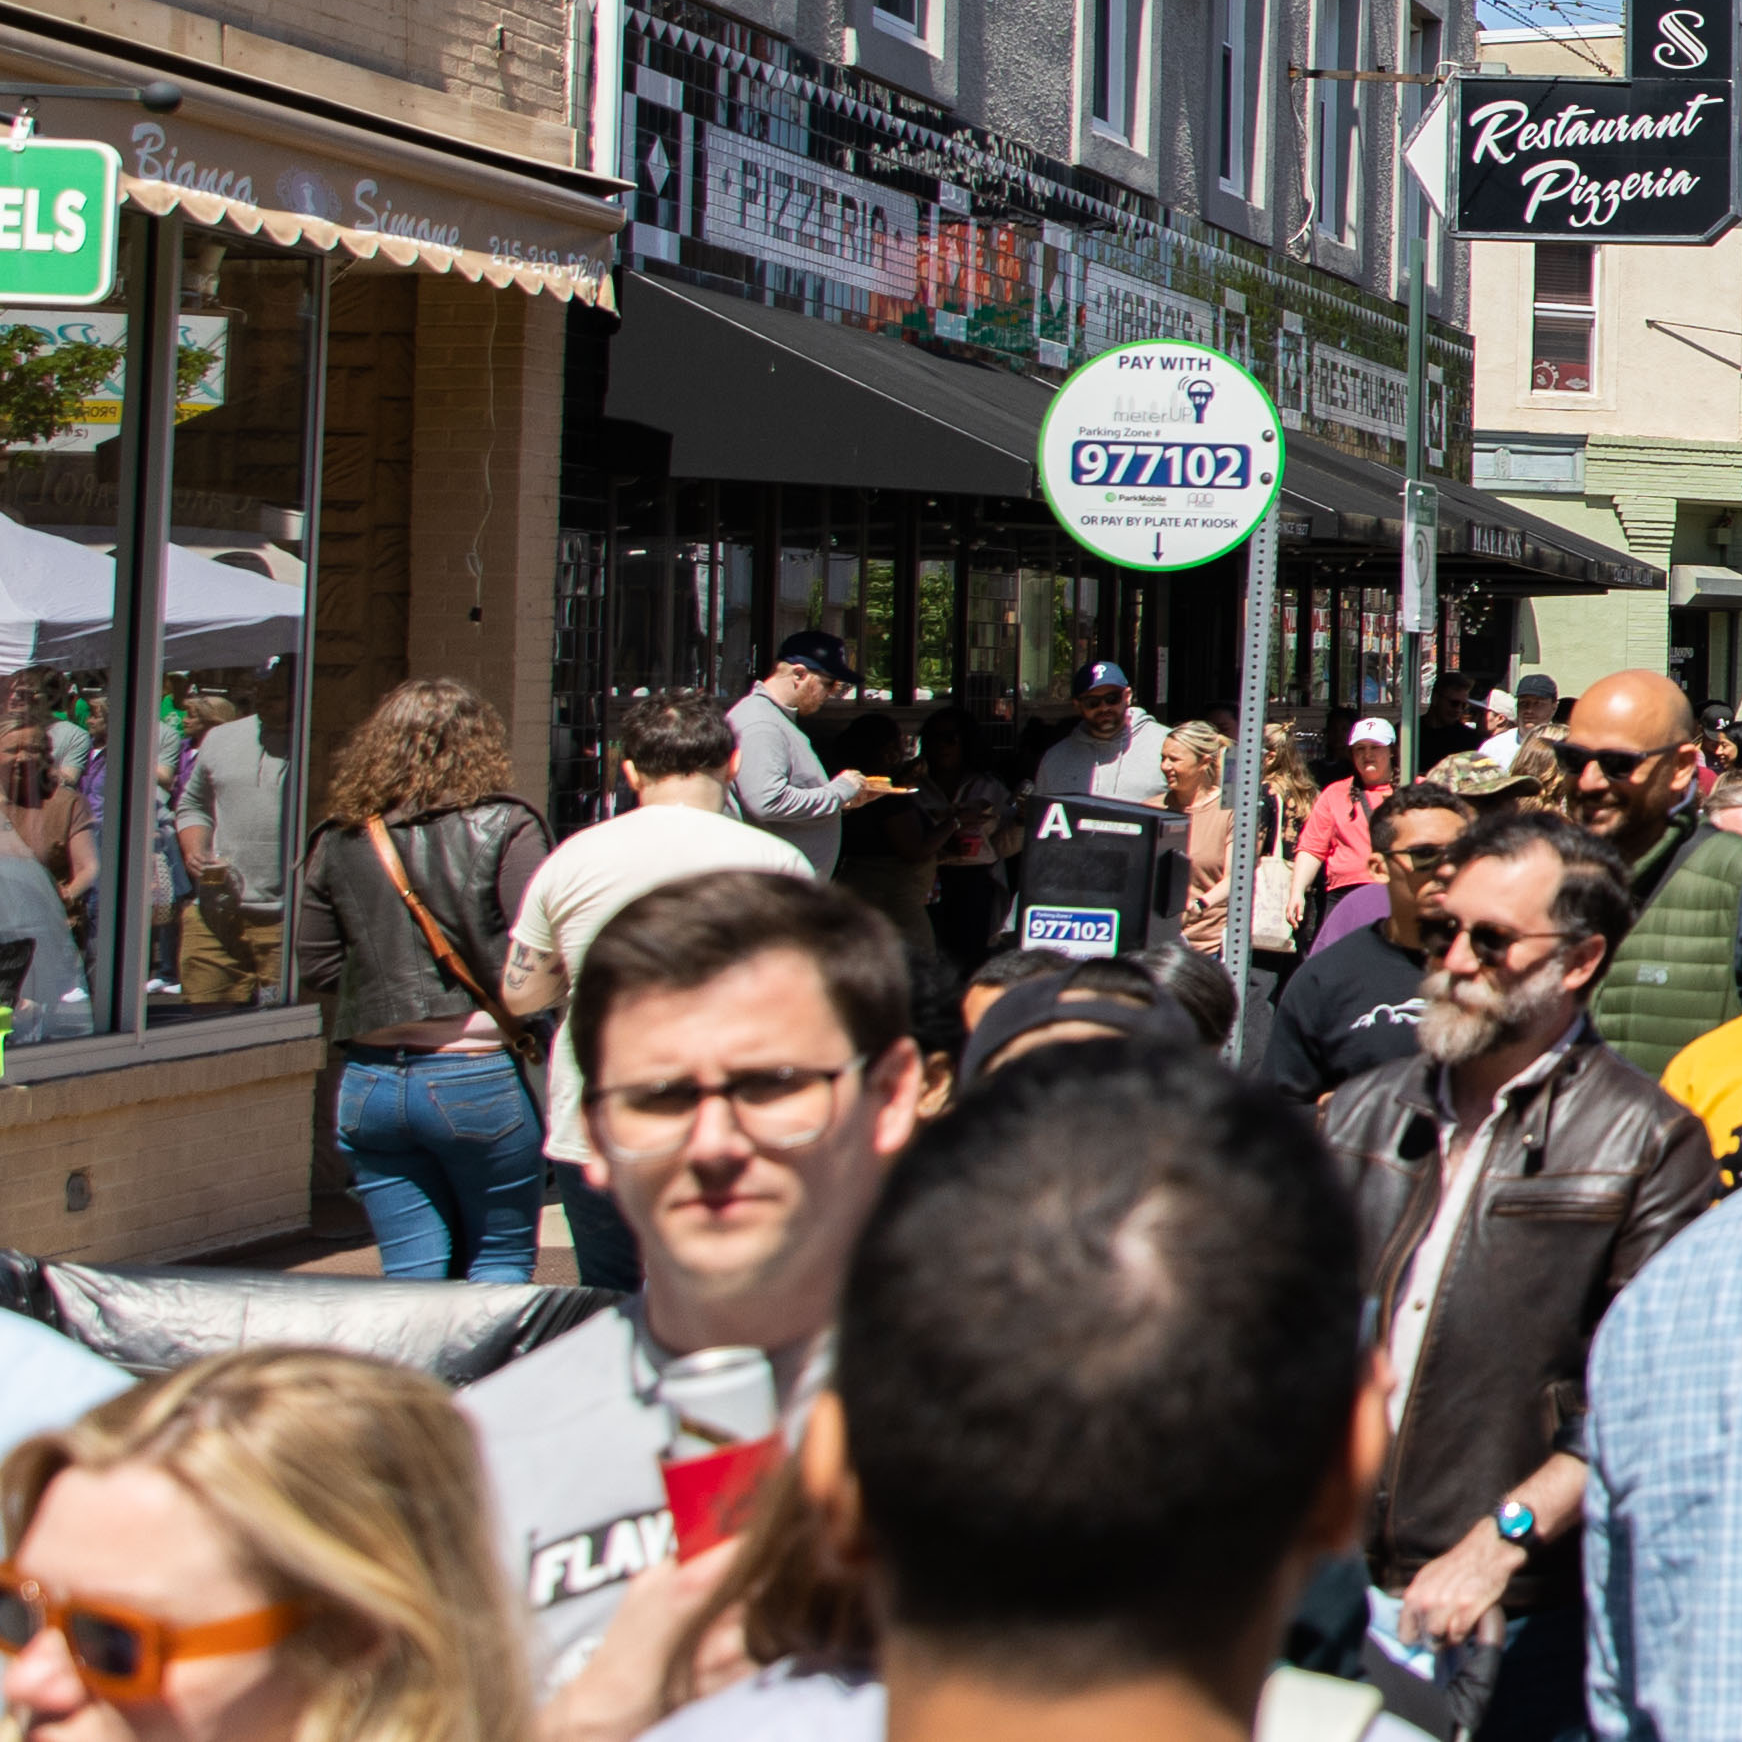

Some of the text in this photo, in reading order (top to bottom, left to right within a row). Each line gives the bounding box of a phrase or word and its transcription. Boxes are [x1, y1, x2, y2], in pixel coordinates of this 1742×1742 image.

[1468, 93, 1725, 166] Restaurant
[130, 121, 259, 208] Bianca
[1520, 159, 1701, 229] Pizzeria
[1117, 355, 1212, 372] PAY WITH
[1318, 358, 1418, 426] RESTAURAN
[1078, 427, 1121, 440] Parking
[1123, 428, 1152, 438] Zone
[1078, 443, 1243, 487] 977102
[1081, 515, 1239, 529] OR PAY BY PLATE AT KIOSK
[1036, 802, 1073, 839] A
[1030, 920, 1111, 941] 977102
